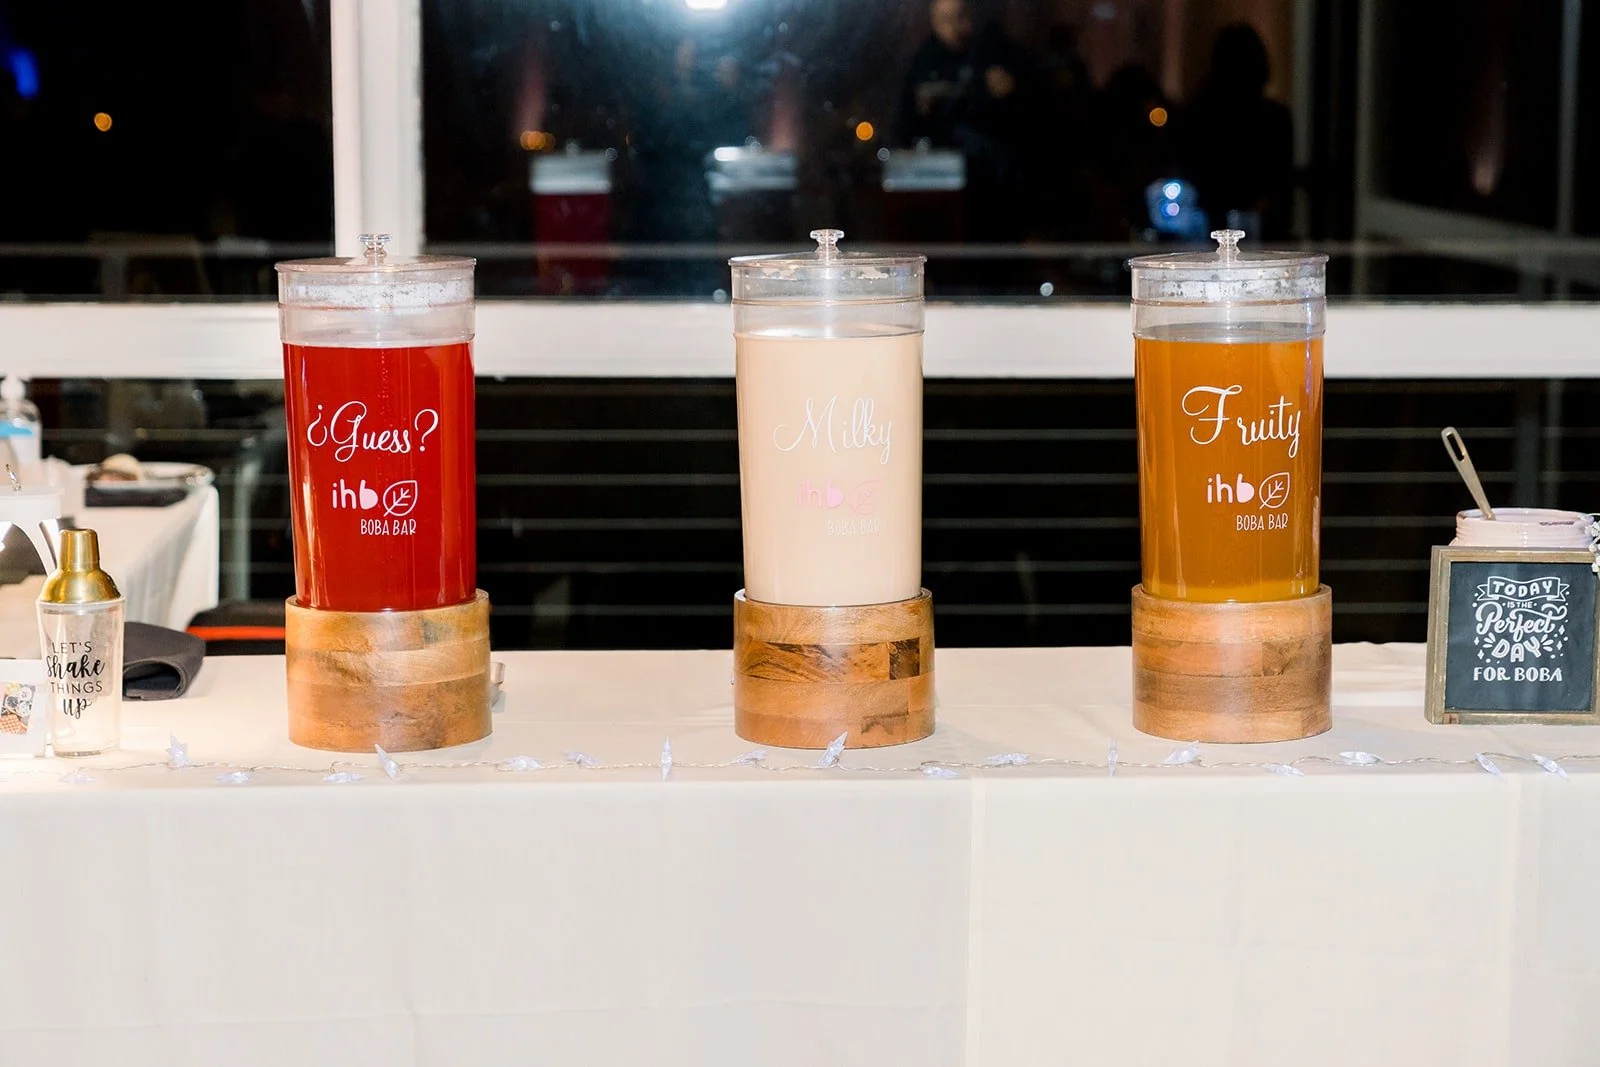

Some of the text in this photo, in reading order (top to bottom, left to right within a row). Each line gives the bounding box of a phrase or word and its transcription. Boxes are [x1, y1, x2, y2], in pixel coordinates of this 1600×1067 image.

[307, 401, 438, 462] ¿Guess?
[773, 395, 892, 464] Milky
[1182, 384, 1301, 458] Fruity
[332, 479, 379, 510] ihb
[1207, 473, 1255, 503] ihb
[360, 518, 417, 536] BOBA BAR
[1236, 512, 1288, 531] BOBA BAR
[1493, 580, 1553, 598] TODAY
[1475, 601, 1567, 643] Perfect
[53, 641, 92, 654] LET'S
[1491, 635, 1541, 663] DAY
[50, 681, 103, 695] THINGS
[1473, 666, 1562, 682] FOR BOBA
